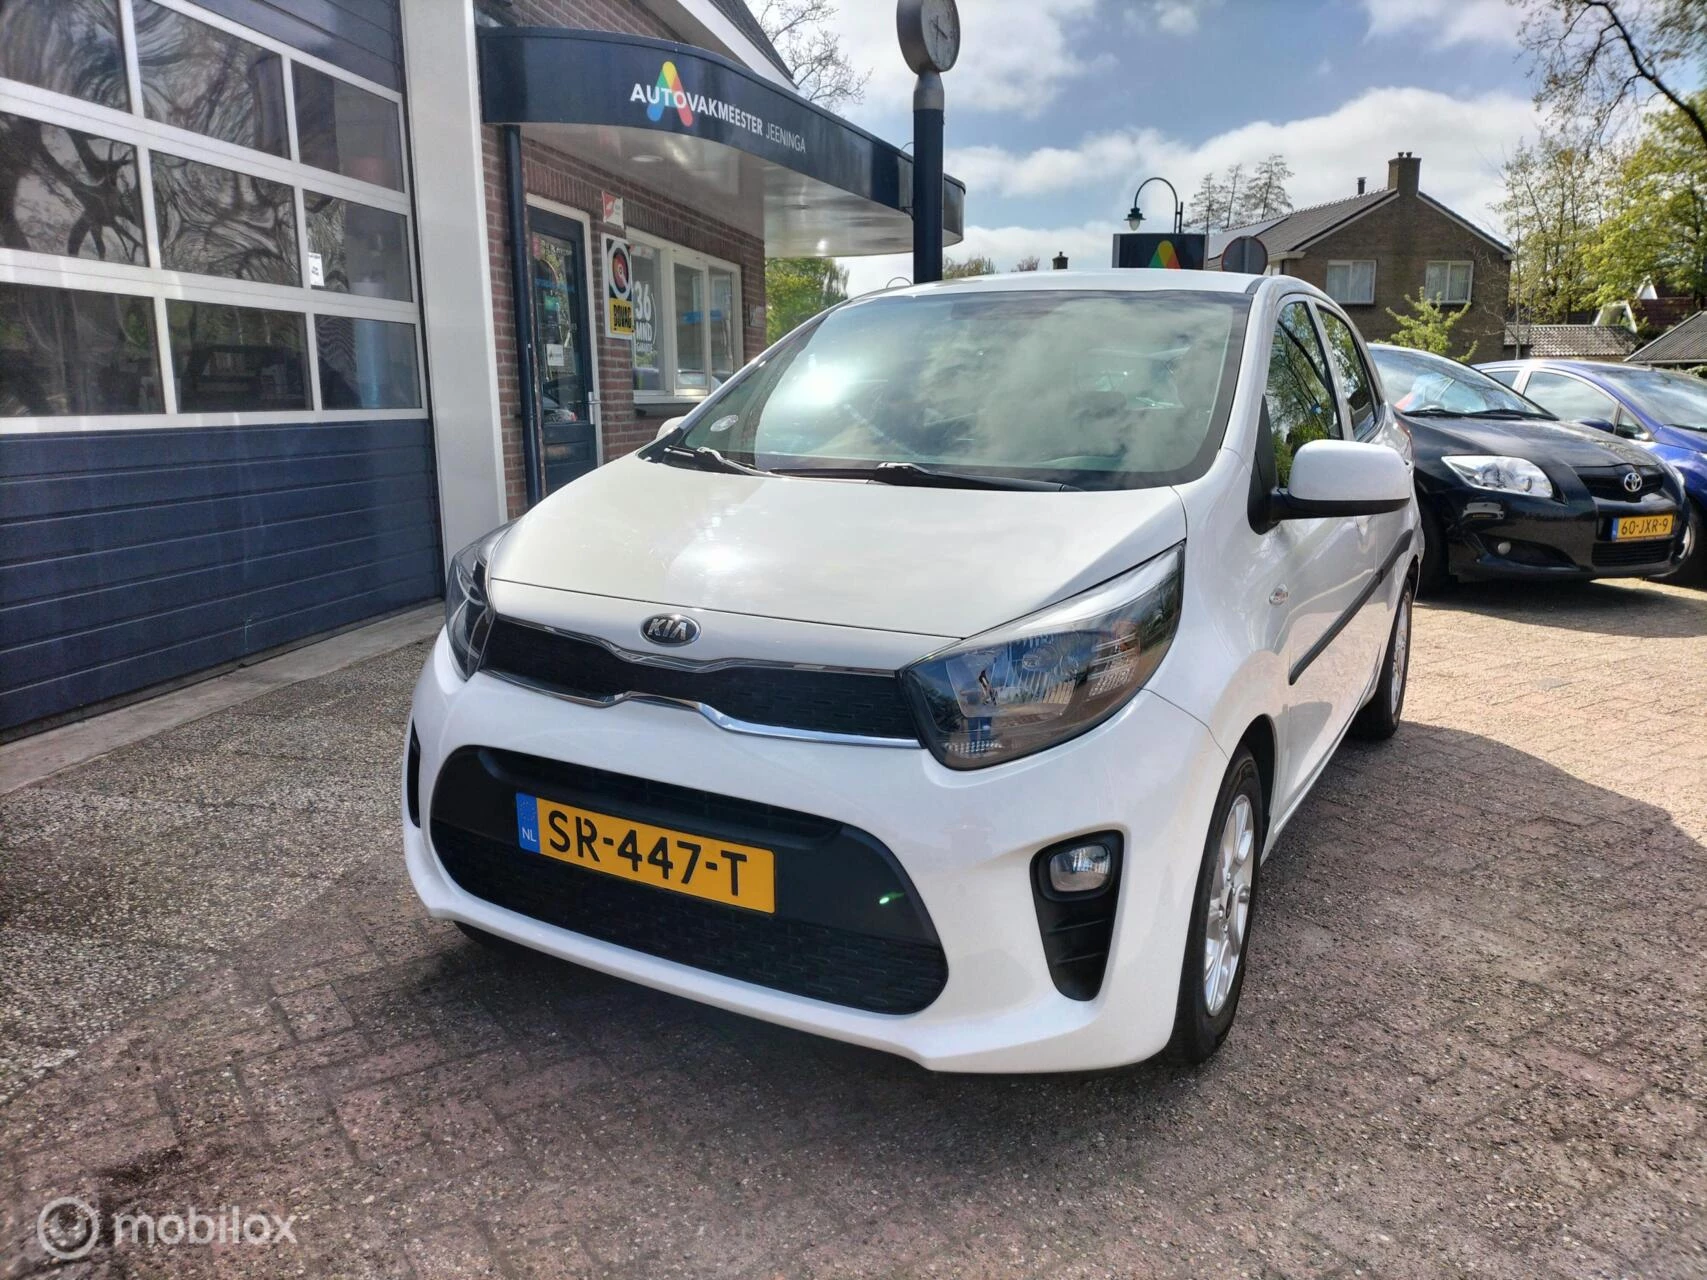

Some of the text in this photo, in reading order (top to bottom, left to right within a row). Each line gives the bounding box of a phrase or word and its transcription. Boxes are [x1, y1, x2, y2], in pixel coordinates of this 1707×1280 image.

[630, 83, 806, 153] AUTOVAKMEESTER JEENINGA
[634, 281, 652, 321] 36
[1621, 518, 1668, 535] 60-JXR-9
[647, 618, 688, 640] KIA
[521, 826, 537, 843] NL
[548, 810, 748, 897] SR-447-T
